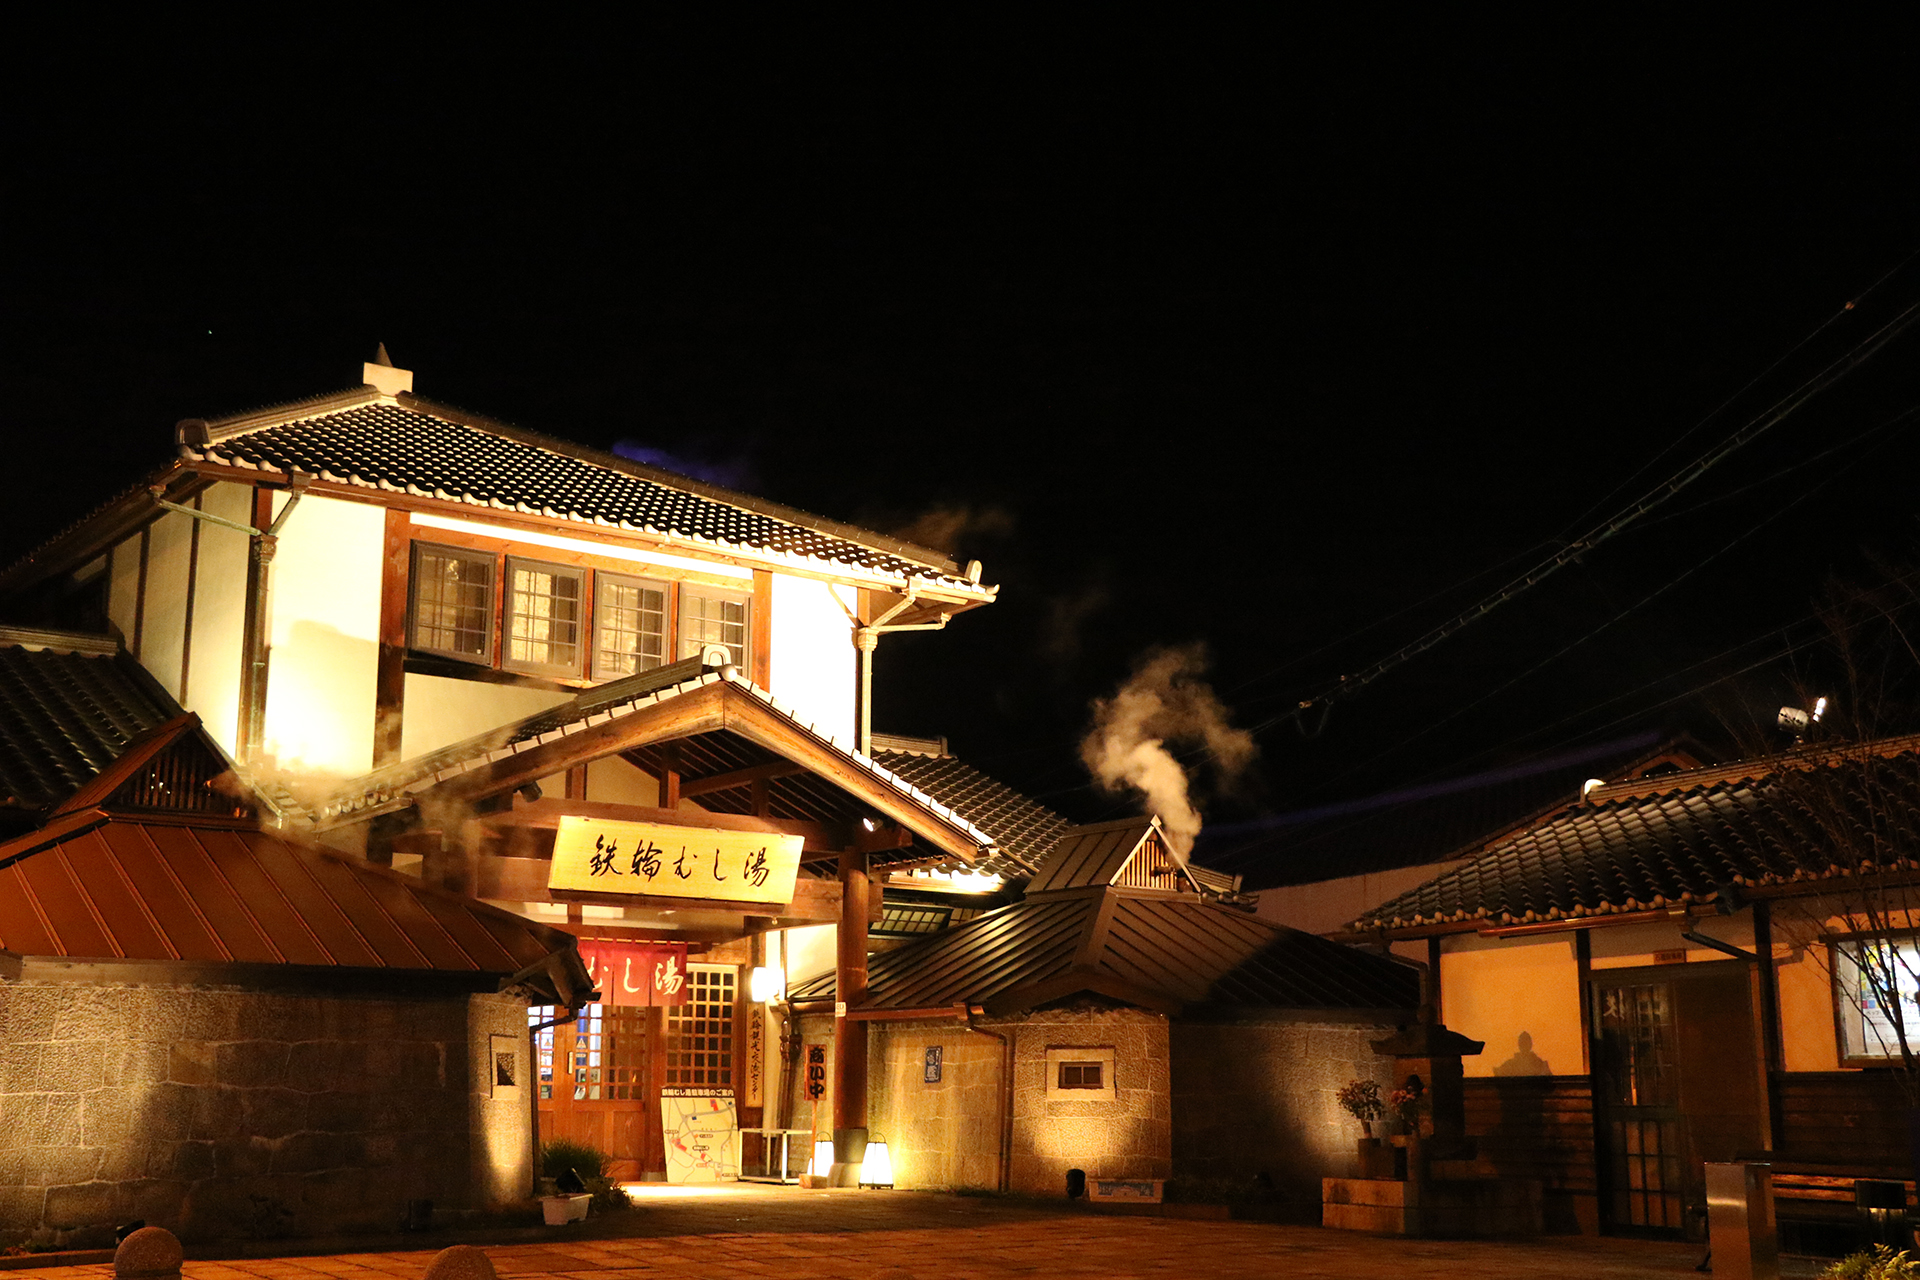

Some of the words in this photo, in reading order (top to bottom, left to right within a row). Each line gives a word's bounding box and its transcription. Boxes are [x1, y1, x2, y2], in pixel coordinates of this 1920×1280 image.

[590, 834, 770, 887] 鉄輪むし湯
[809, 1047, 824, 1099] 商い中
